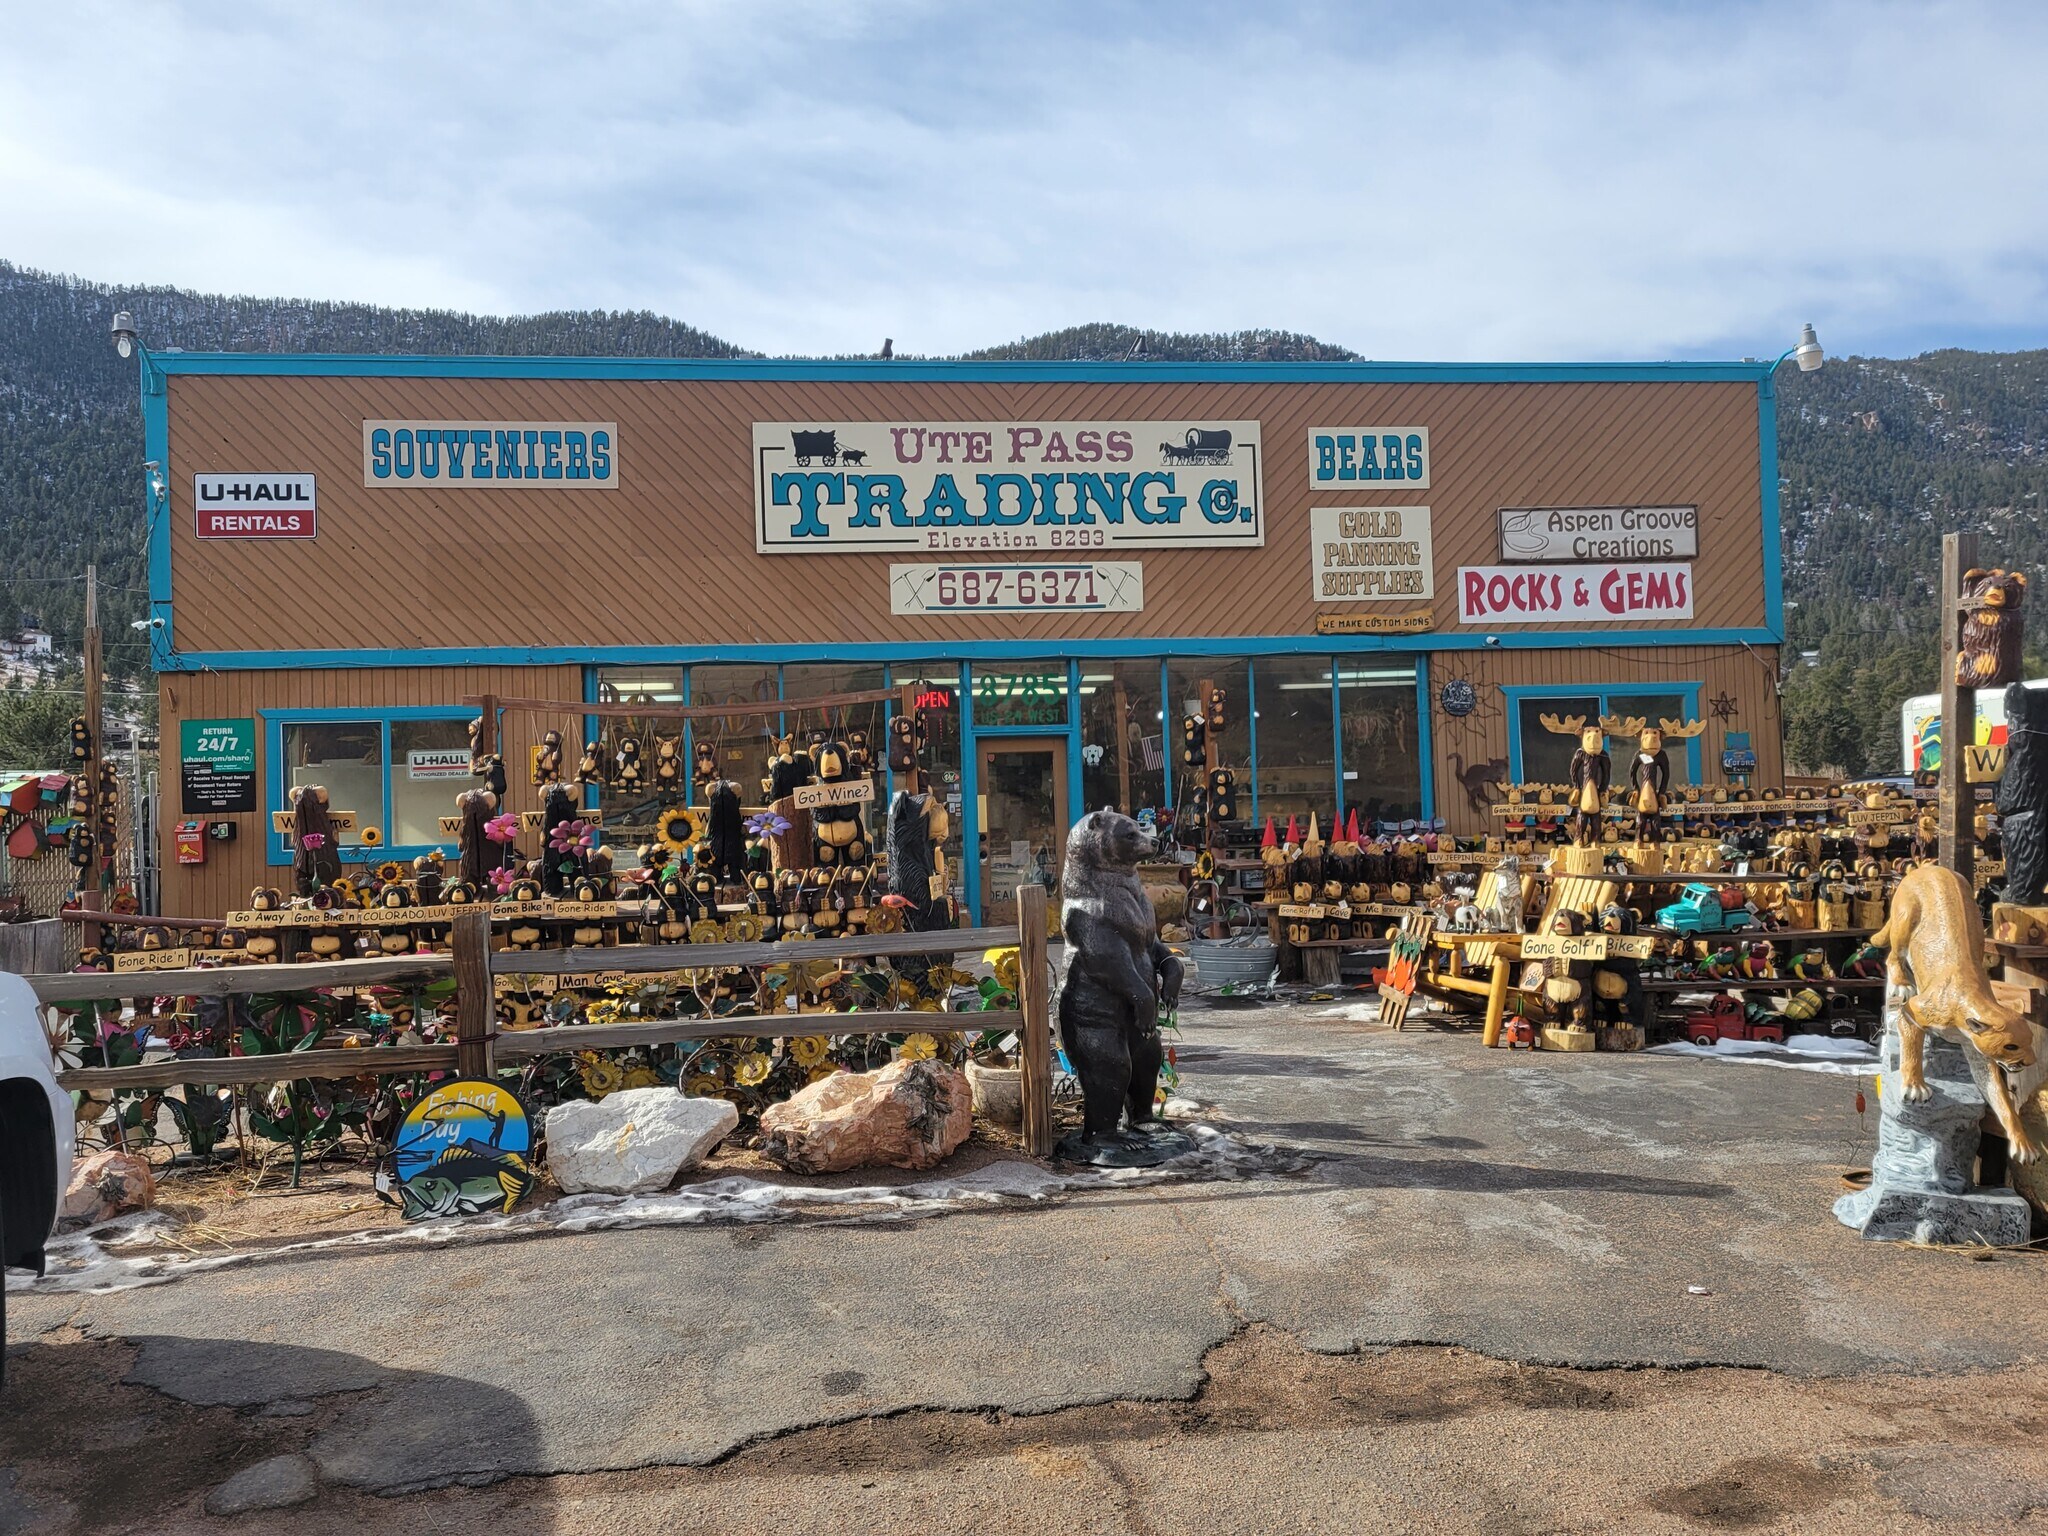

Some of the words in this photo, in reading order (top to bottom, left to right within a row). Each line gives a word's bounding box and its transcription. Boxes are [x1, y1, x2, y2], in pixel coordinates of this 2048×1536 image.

[890, 427, 993, 464] UTE
[1007, 427, 1134, 463] PASS
[371, 428, 611, 480] SOUVENIERS
[1316, 434, 1423, 480] BEARS
[201, 483, 309, 502] U-HAUL
[771, 471, 1187, 537] TRADING
[211, 514, 300, 532] RENTALS
[1338, 511, 1402, 538] GOLD
[1548, 511, 1610, 533] Aspen
[1621, 509, 1695, 530] Groove
[927, 530, 1038, 549] Elevation
[1051, 530, 1104, 547] 8293
[1572, 535, 1673, 558] Creations
[1323, 541, 1420, 567] PANNING
[938, 571, 1098, 605] 687-6371
[1322, 570, 1424, 596] SUPPLIES
[1464, 571, 1562, 616] ROCKS
[1574, 577, 1590, 607] &
[1600, 568, 1687, 614] GEMS
[1322, 620, 1335, 629] WE
[1338, 620, 1362, 629] MAKE
[1365, 617, 1400, 628] CUSTOM
[979, 673, 1061, 707] 8785
[981, 712, 997, 723] US
[1004, 711, 1022, 722] 24
[1028, 709, 1060, 722] WEST
[197, 736, 239, 752] 24/7
[184, 755, 250, 763] uhaul.com/share
[413, 755, 468, 766] U-HAUL
[1724, 758, 1755, 768] Corona
[798, 791, 823, 804] Got
[828, 784, 870, 800] Wine?
[1513, 806, 1537, 814] Fishing
[1715, 804, 1741, 812] roncos
[1743, 803, 1763, 811] oncos
[1852, 814, 1868, 822] LUV
[1871, 812, 1900, 821] JEEPIN
[1430, 854, 1446, 862] LUV
[1447, 853, 1471, 862] JEEPIN
[1475, 855, 1500, 863] COLOR
[364, 910, 425, 921] COLORADO
[428, 908, 447, 919] LUV
[450, 905, 487, 918] JEEPIN
[493, 904, 519, 915] Gone
[521, 902, 552, 913] Bike'n
[558, 904, 582, 914] Gone
[583, 903, 615, 913] Ride'n
[1281, 907, 1298, 915] Gone
[1330, 907, 1349, 917] Cave
[235, 913, 250, 923] Go
[255, 913, 285, 923] Away
[294, 913, 320, 923] Gone
[323, 911, 355, 922] Bike'n
[1524, 939, 1555, 954] Gone
[1561, 938, 1603, 956] Golf'n
[1607, 938, 1647, 953] Bike'n
[118, 957, 145, 967] Gone
[149, 953, 184, 965] Ride'n
[562, 976, 590, 987] Man
[594, 972, 624, 986] Cave
[629, 976, 657, 984] Custo
[427, 1090, 498, 1117] Fishing
[419, 1119, 462, 1143] Day
